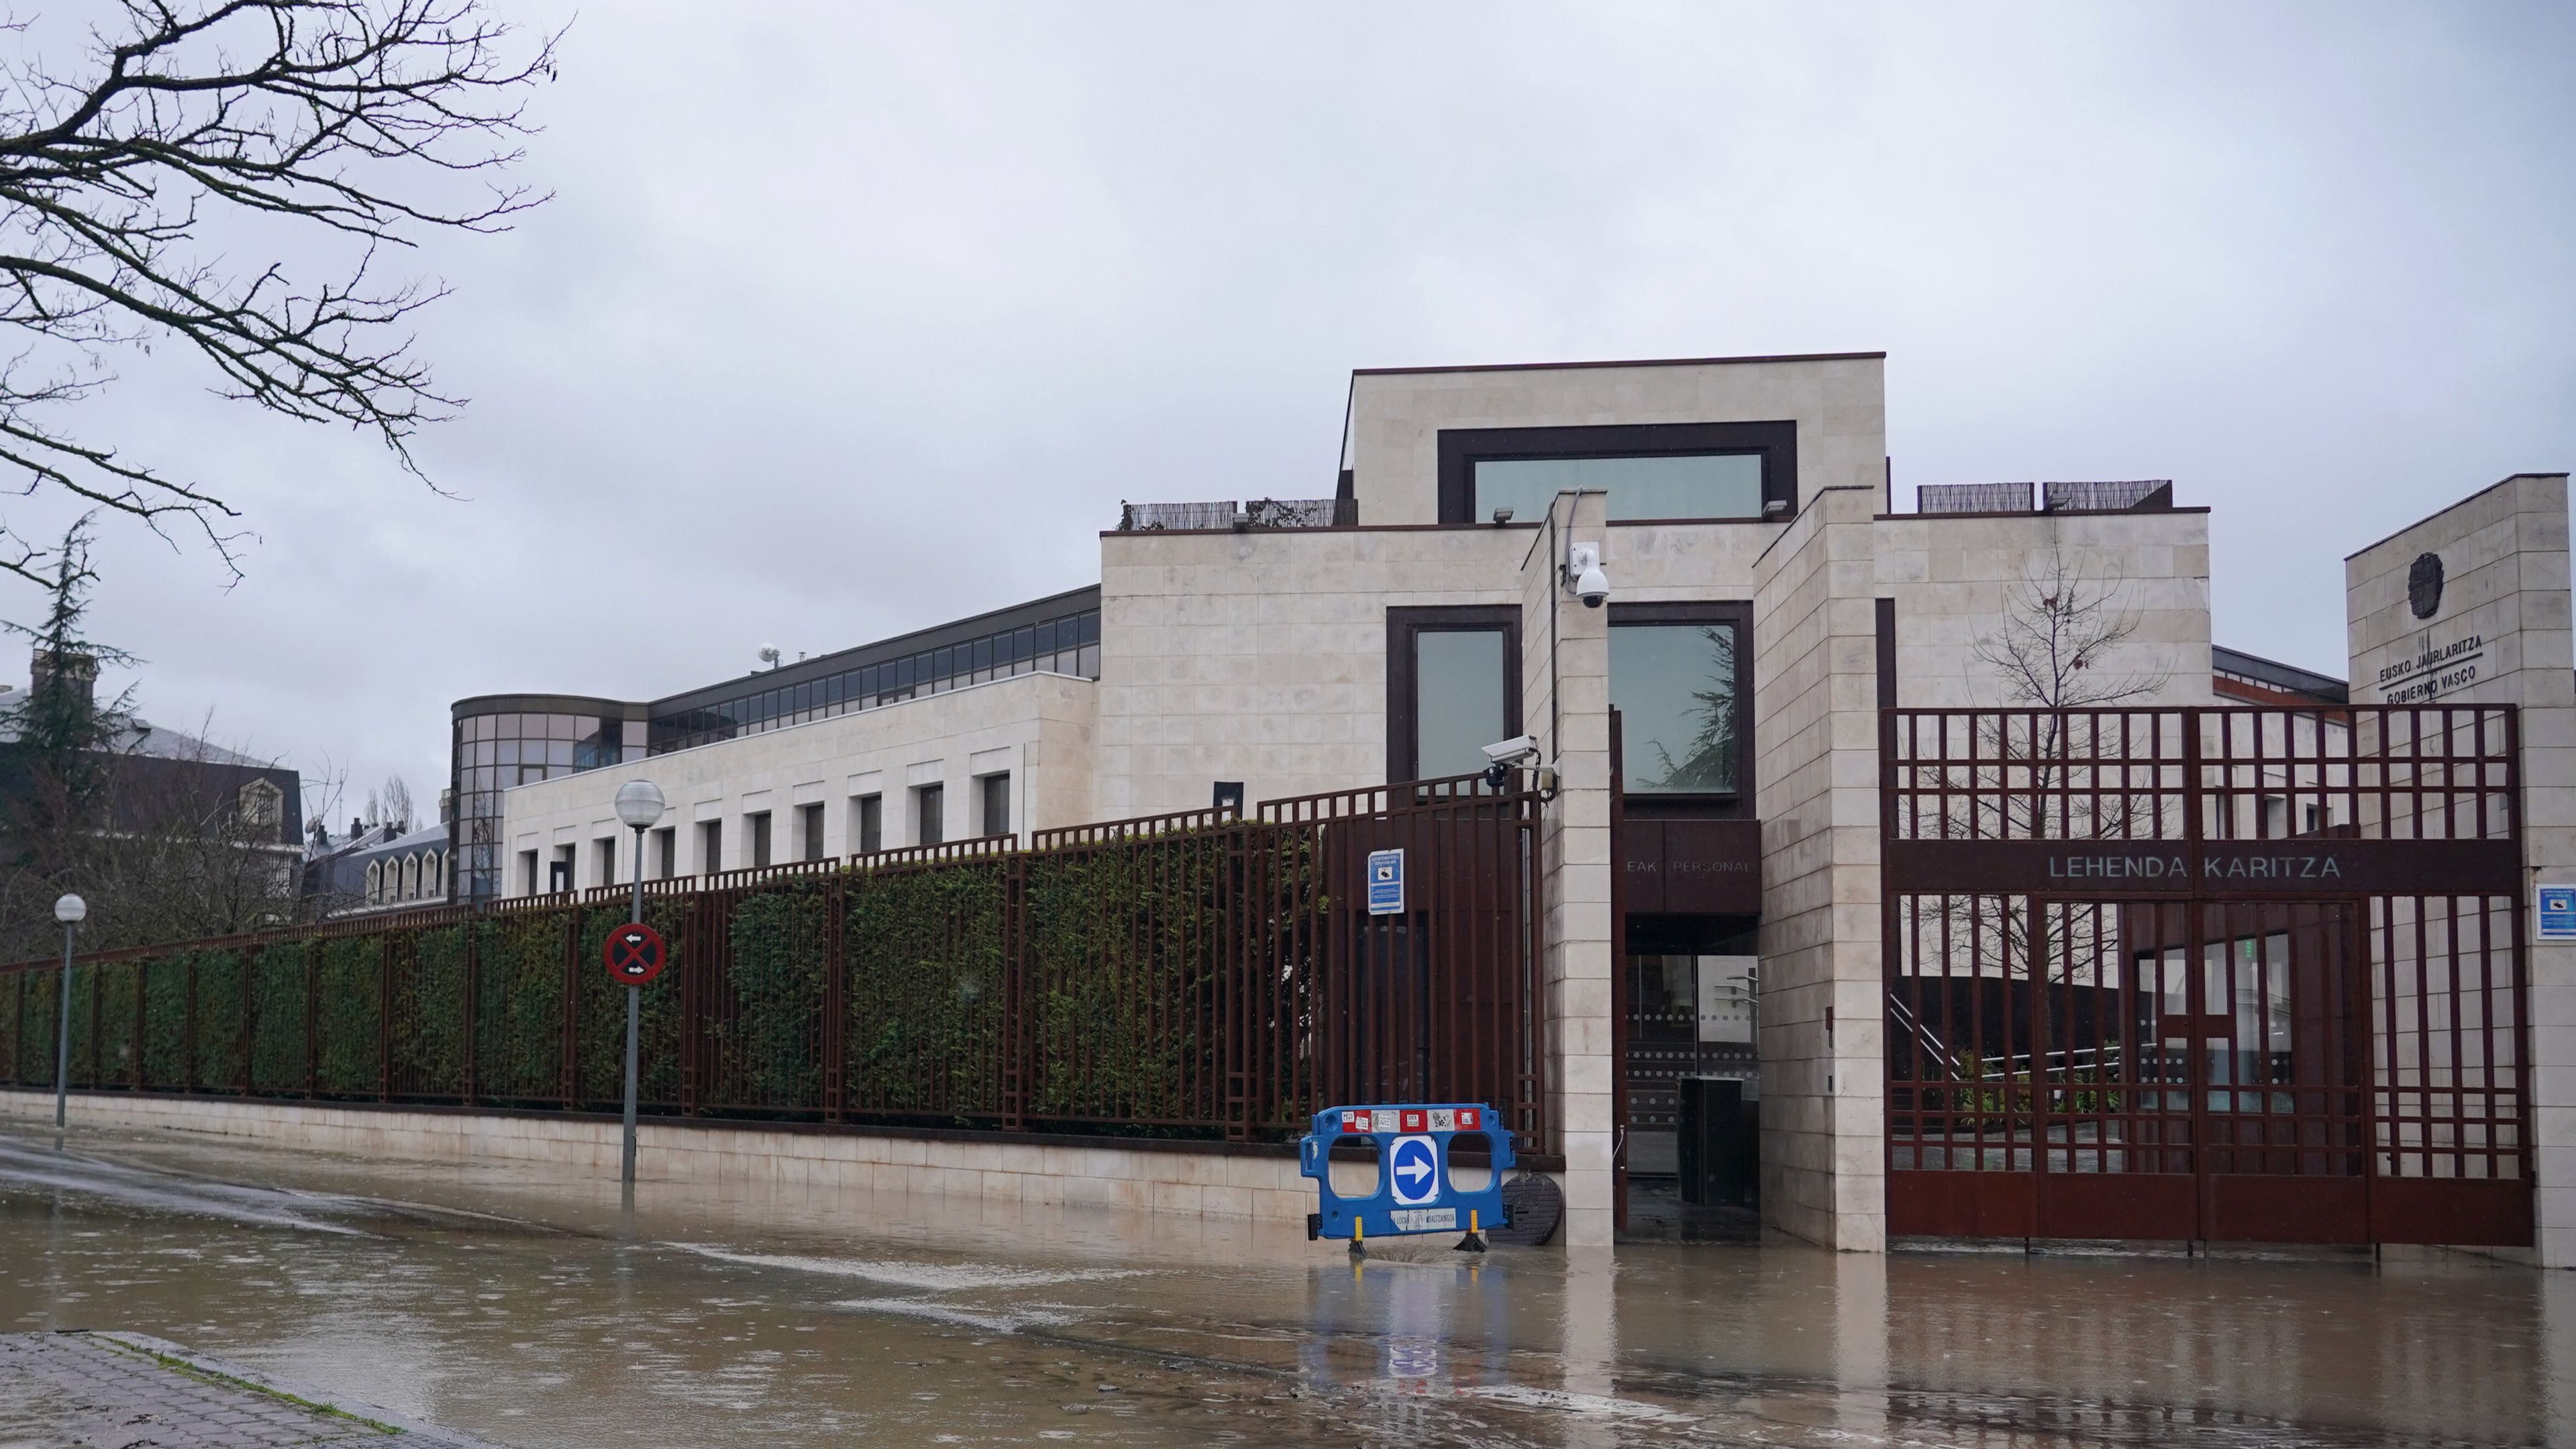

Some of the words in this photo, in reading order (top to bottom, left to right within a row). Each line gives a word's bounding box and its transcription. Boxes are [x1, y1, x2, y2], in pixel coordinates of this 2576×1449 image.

[2379, 660, 2411, 682] EUSKO
[2416, 634, 2482, 669] JAURLARITZA
[2387, 679, 2437, 704] GOBIERNO
[2441, 665, 2476, 689] VASCO
[1624, 861, 1657, 872] EAK
[1673, 861, 1750, 872] PERSONAL
